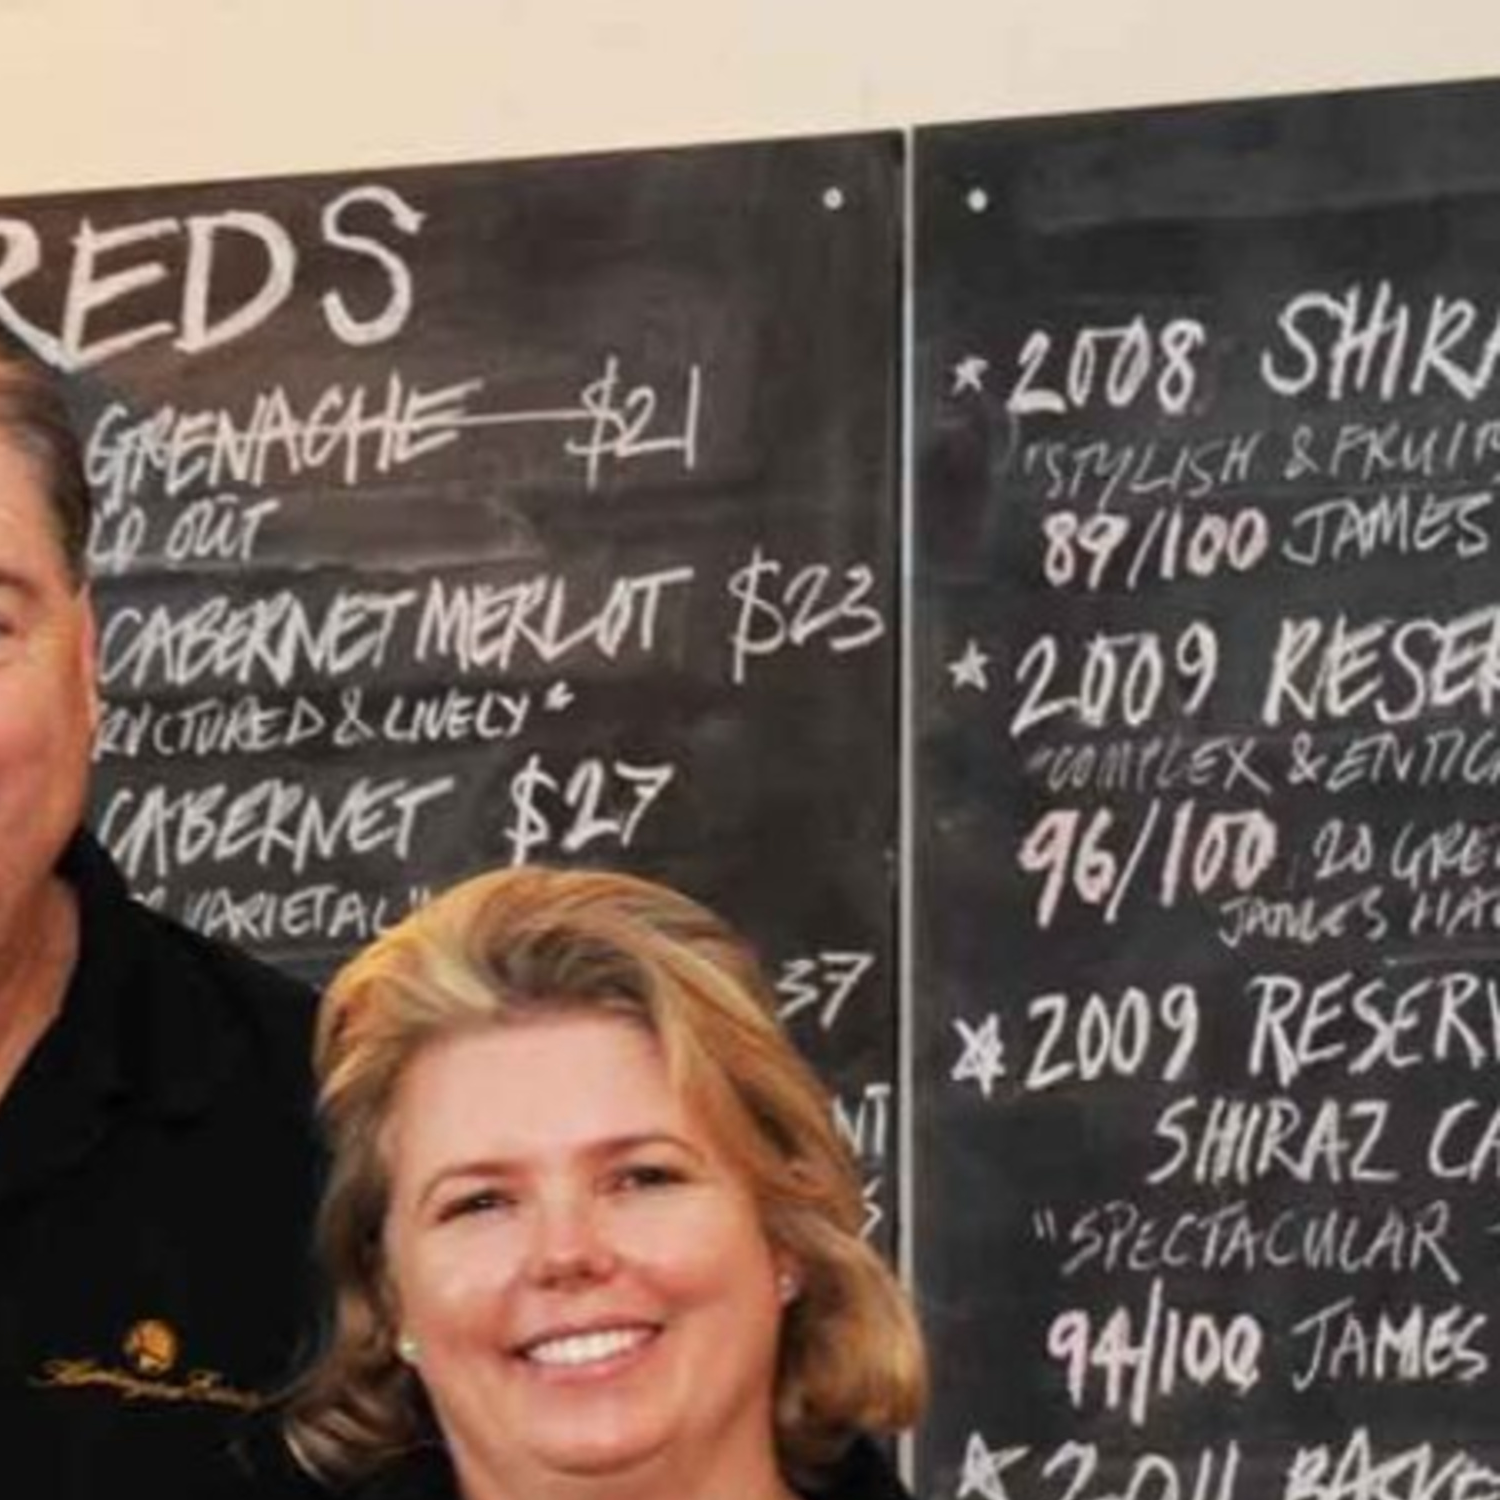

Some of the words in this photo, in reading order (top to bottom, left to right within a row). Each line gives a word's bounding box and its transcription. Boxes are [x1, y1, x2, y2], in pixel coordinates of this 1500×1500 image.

[1006, 315, 1204, 413] 2008
[1261, 280, 1500, 400] SHIR
[82, 370, 485, 514] GRENACHE
[566, 356, 700, 491] $21
[1284, 424, 1320, 480] &
[165, 493, 280, 563] OUT
[1043, 509, 1268, 590] 89/100
[1281, 492, 1494, 566] JAMES
[97, 591, 417, 687] CABERNET
[415, 567, 694, 671] MERLOT
[730, 548, 885, 683] $23
[332, 686, 377, 747] &
[1010, 622, 1217, 738] 2009
[1287, 731, 1327, 785] &
[1326, 729, 1500, 791] ENTIC
[97, 778, 454, 880] CABERNET
[505, 754, 673, 866] $27
[1018, 800, 1277, 927] 96/100
[1312, 819, 1372, 880] 20
[1391, 820, 1500, 890] GRE
[775, 952, 874, 1030] 37
[1024, 983, 1199, 1092] 2009
[1146, 1096, 1399, 1186] SHIRAZ
[1047, 1278, 1263, 1425] 94/100
[1292, 1297, 1489, 1391] JAMES
